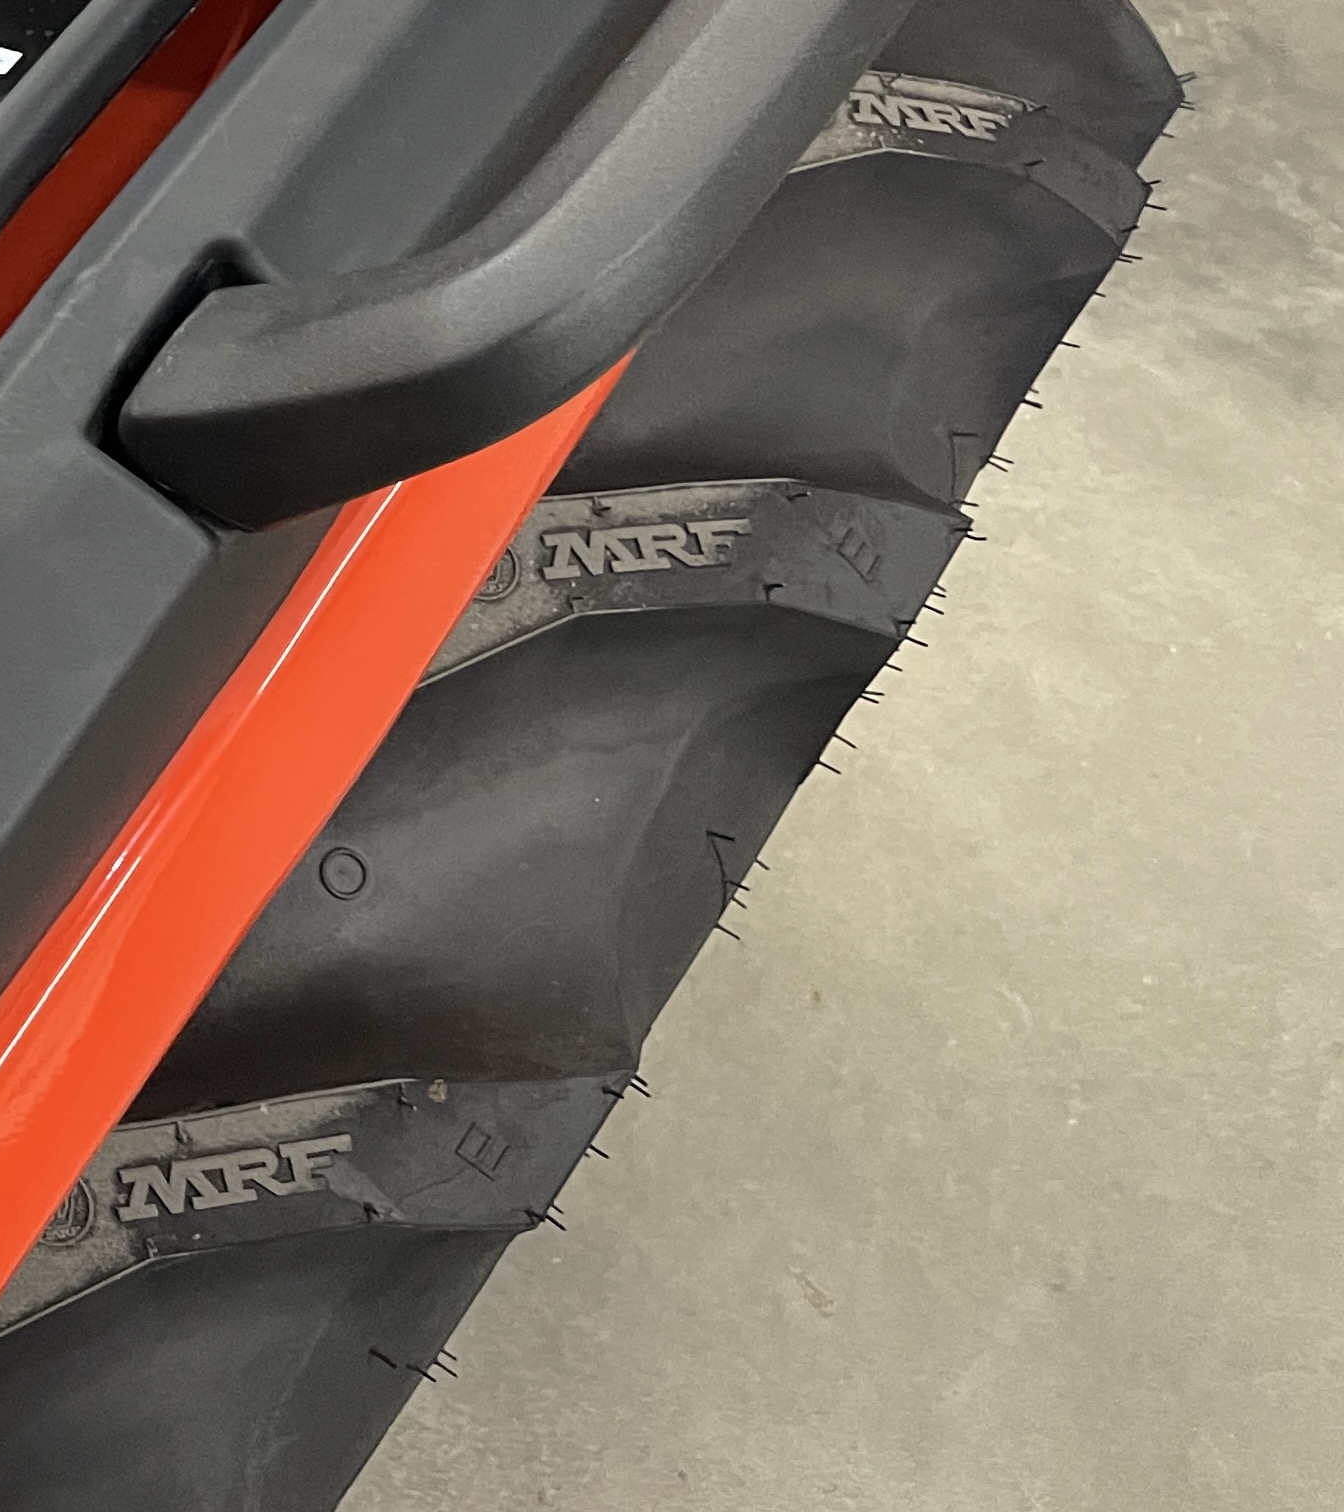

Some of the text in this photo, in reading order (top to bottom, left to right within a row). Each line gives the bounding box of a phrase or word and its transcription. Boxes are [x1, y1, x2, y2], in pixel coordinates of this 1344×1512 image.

[850, 92, 1009, 142] MRF
[542, 518, 753, 580] MRF
[116, 1133, 353, 1222] MRF
